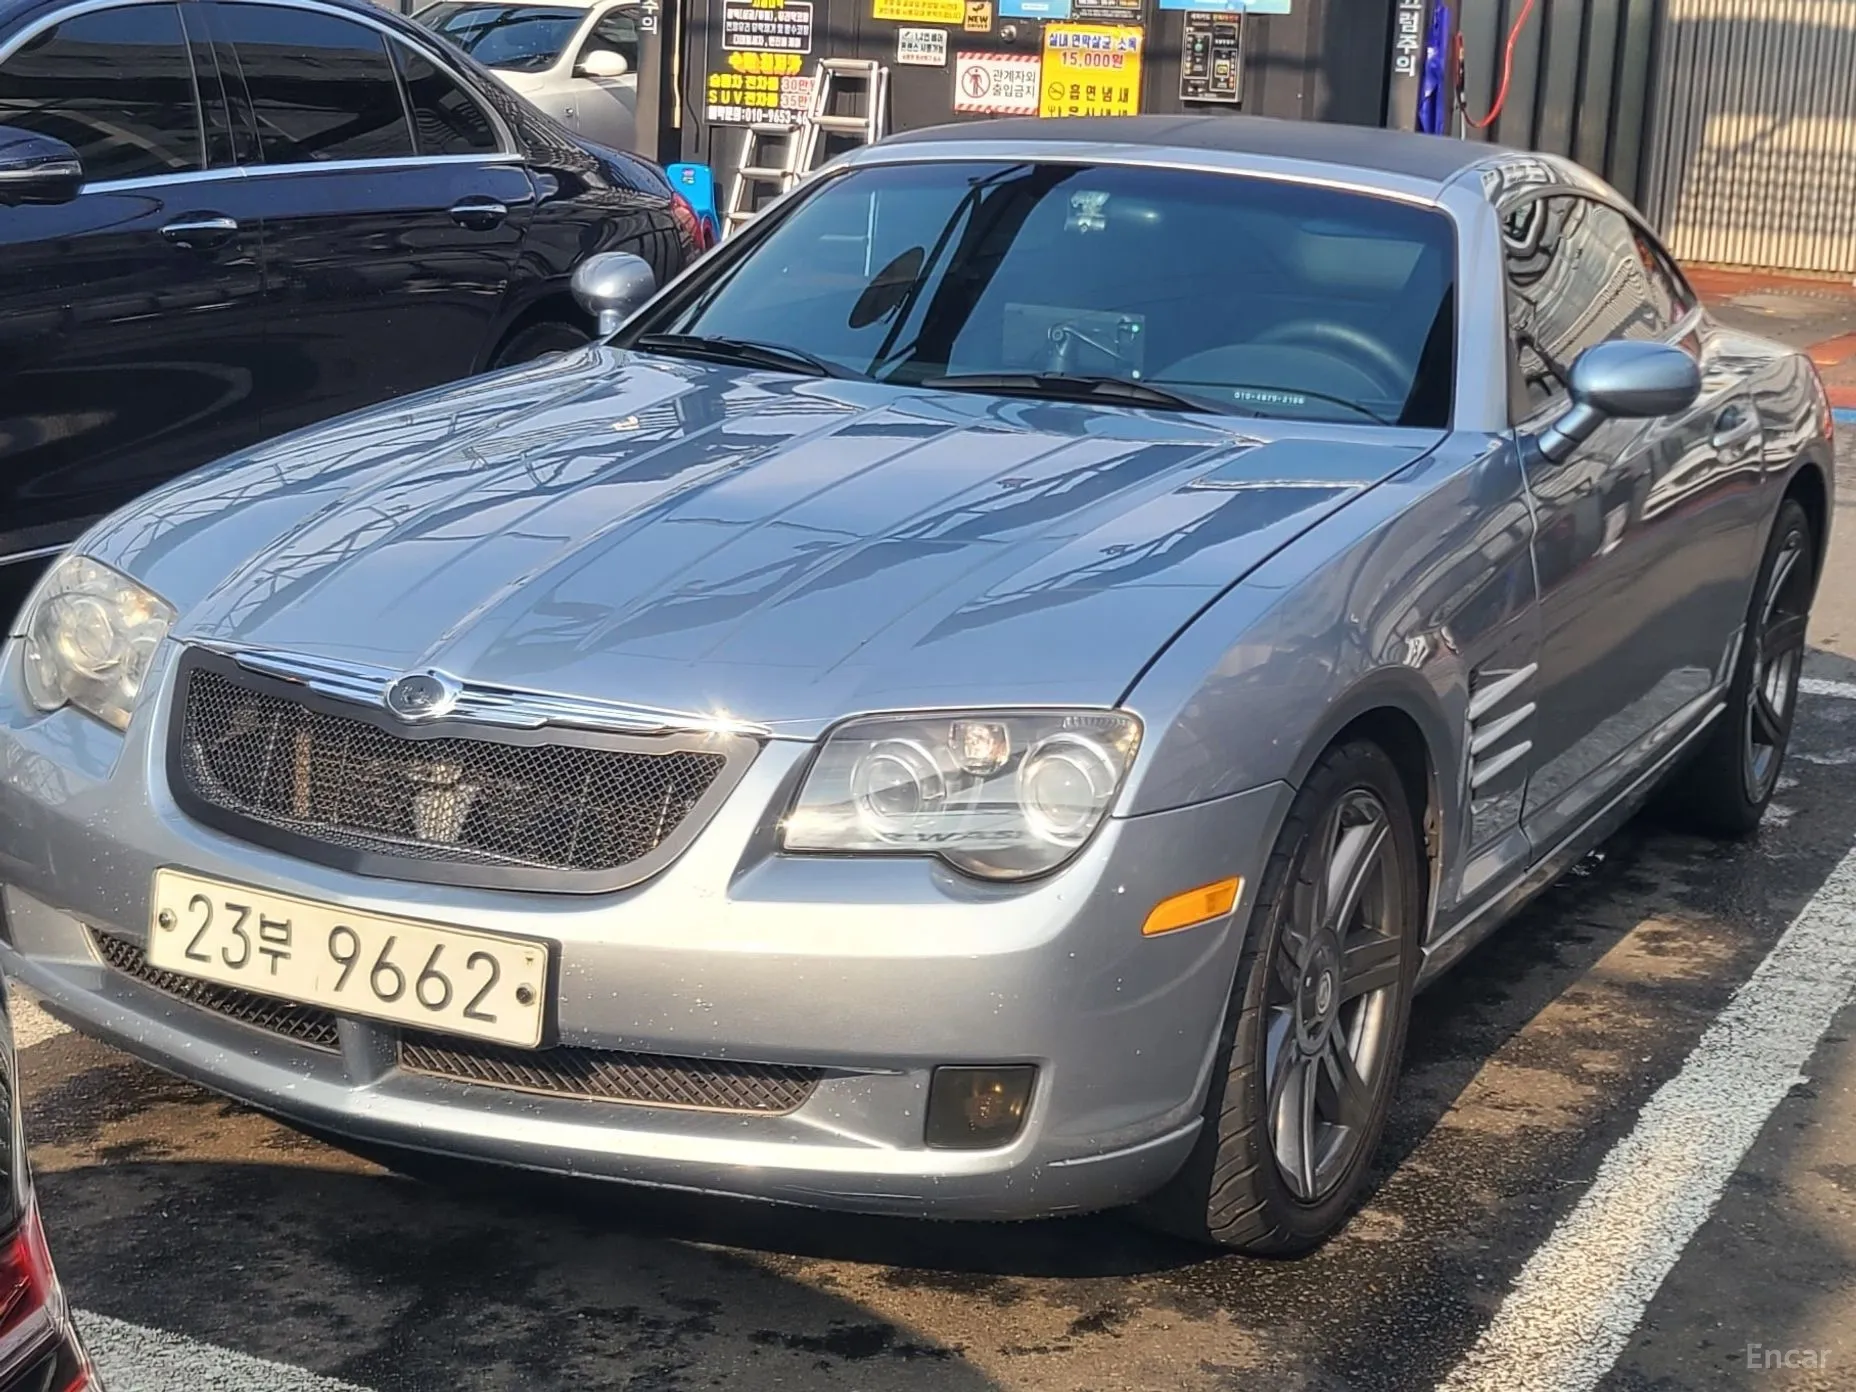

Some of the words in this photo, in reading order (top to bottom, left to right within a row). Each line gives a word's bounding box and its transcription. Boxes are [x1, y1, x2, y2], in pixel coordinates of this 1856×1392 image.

[967, 15, 989, 24] NEW
[1049, 32, 1069, 47] 실내
[1061, 51, 1124, 69] 15,000원
[992, 69, 1036, 83] 관계자외
[992, 84, 1035, 99] 출입금지
[184, 893, 293, 976] 23부
[328, 925, 501, 1024] 9662
